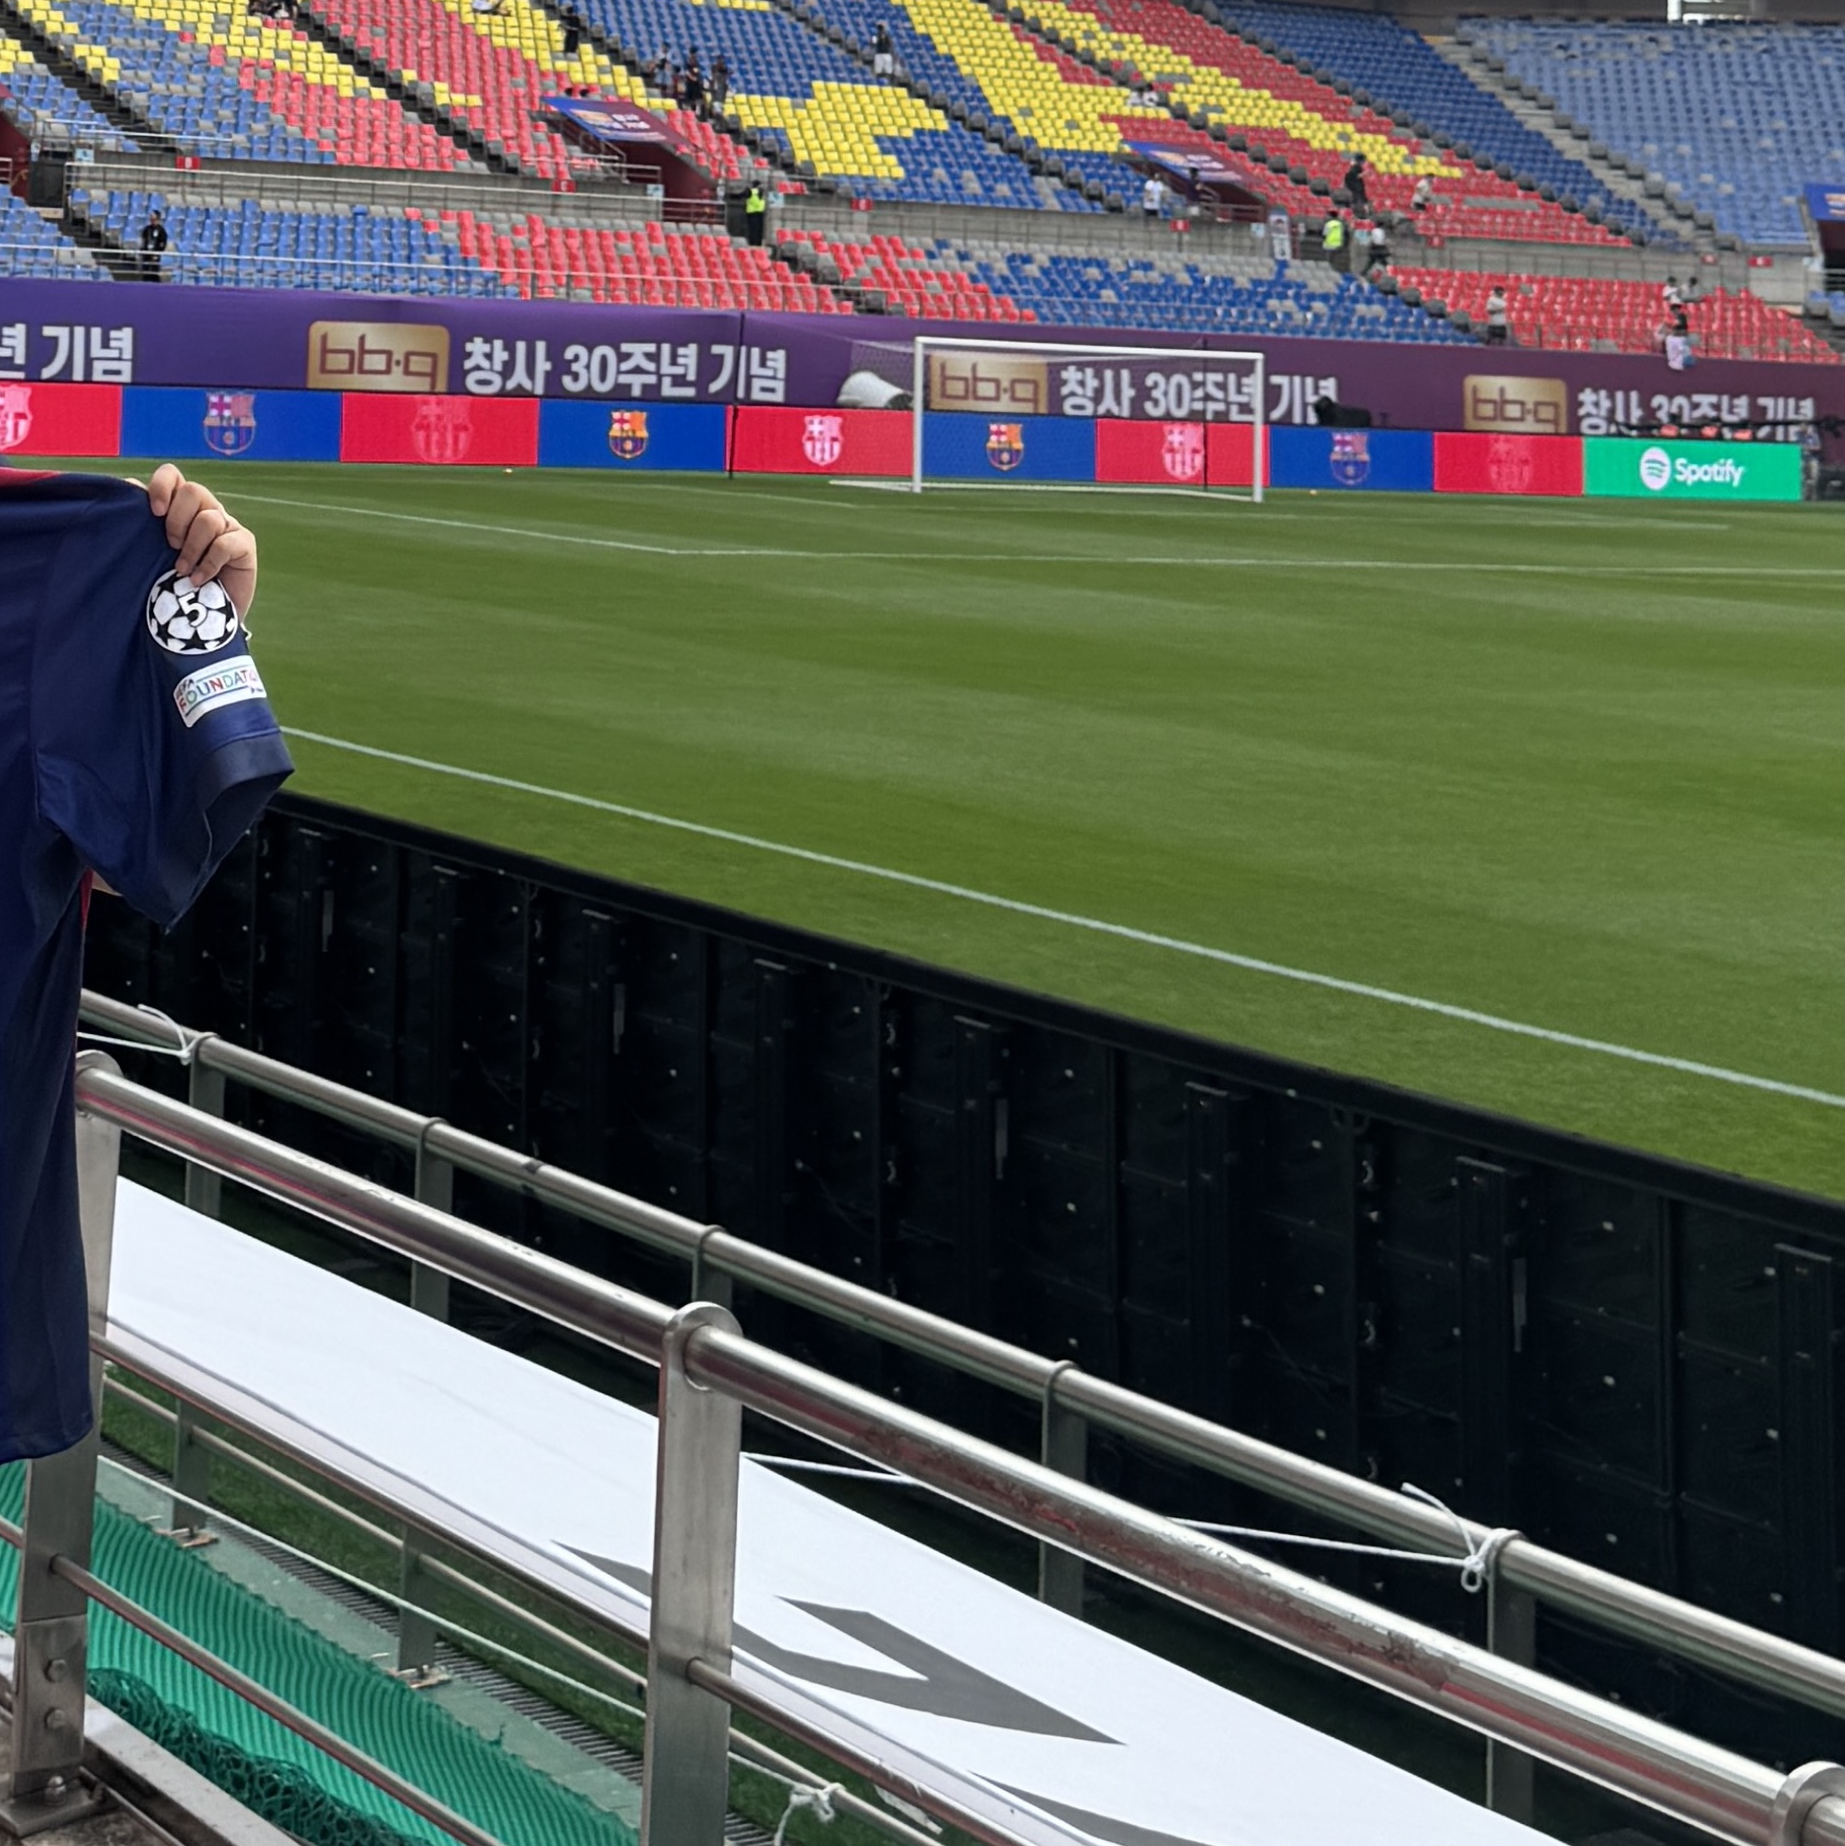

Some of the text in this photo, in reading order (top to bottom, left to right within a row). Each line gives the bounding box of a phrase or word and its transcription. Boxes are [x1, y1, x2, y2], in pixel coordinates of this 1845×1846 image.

[41, 326, 135, 383] 기념
[463, 337, 551, 394] 창사
[561, 341, 698, 398] 30주년
[708, 344, 787, 402] 기념
[1060, 365, 1135, 418] 창사
[1144, 372, 1257, 422] 30주년
[1674, 457, 1744, 488] Spotify
[178, 591, 209, 628] 5
